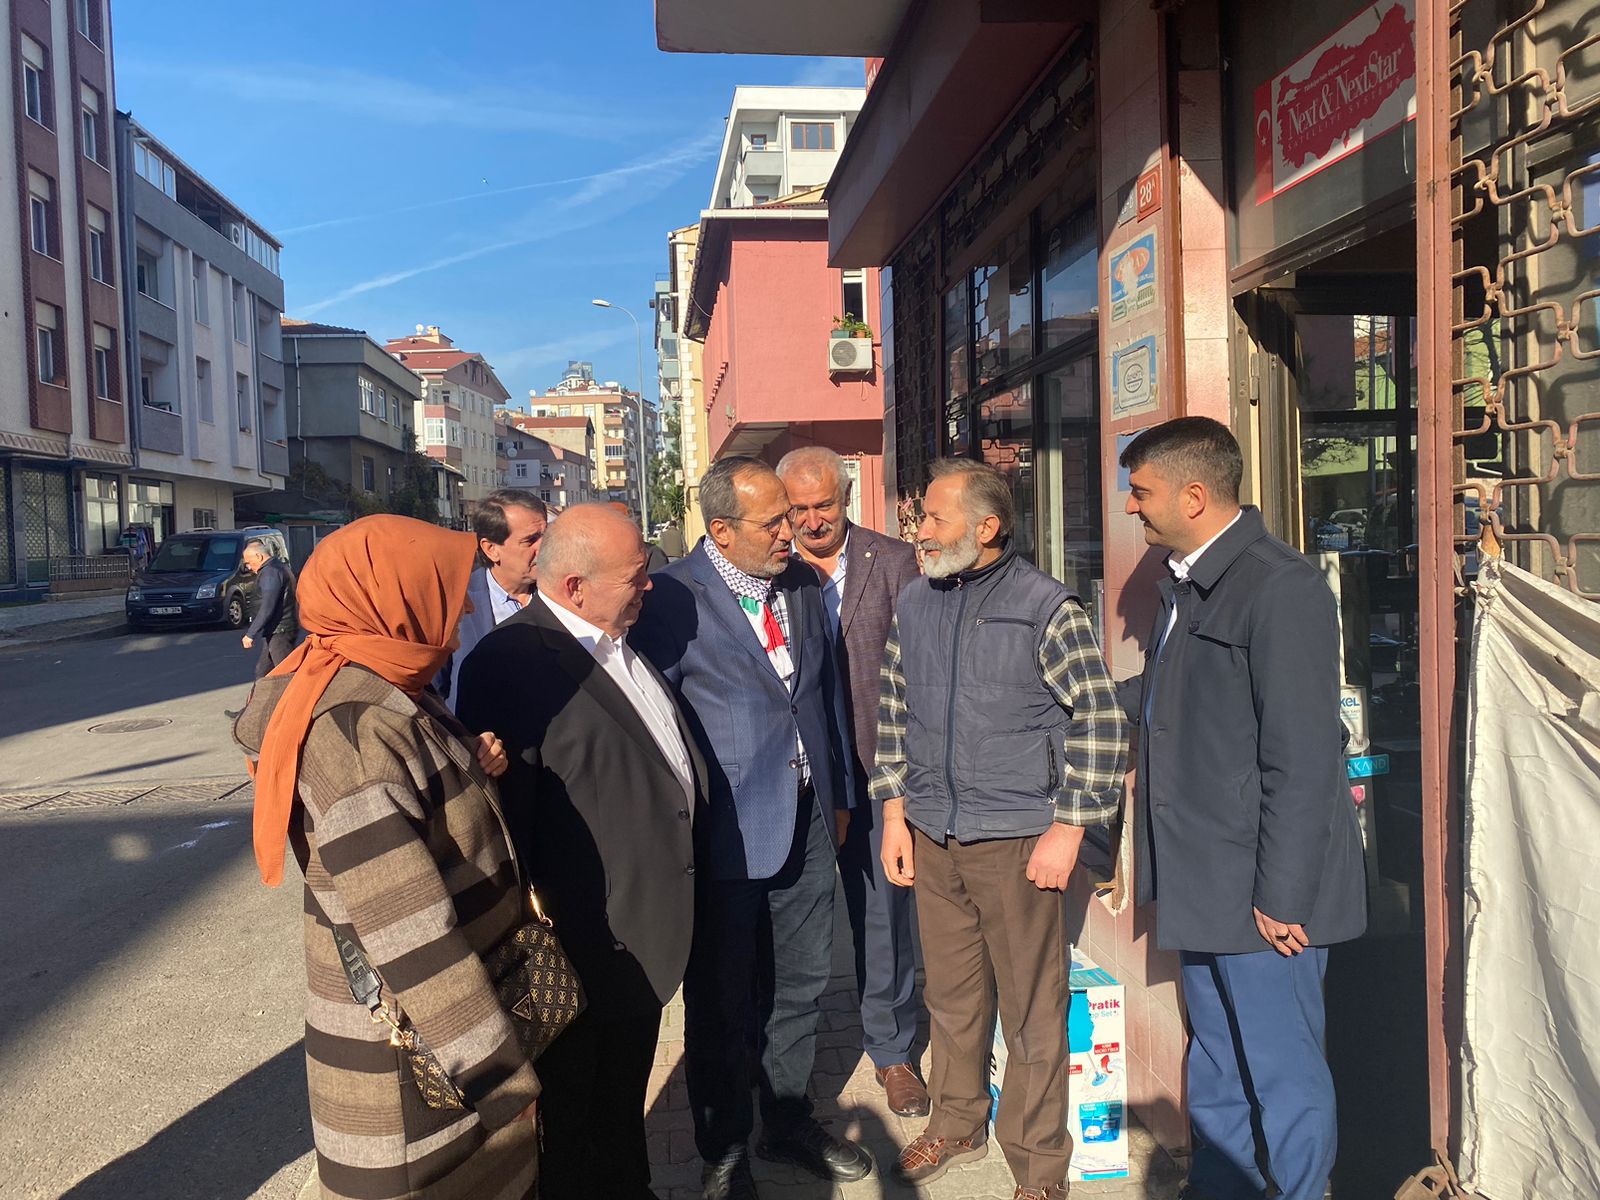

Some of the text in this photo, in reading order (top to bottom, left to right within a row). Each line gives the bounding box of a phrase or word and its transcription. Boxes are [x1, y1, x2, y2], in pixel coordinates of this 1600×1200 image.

[1288, 49, 1402, 141] Next & NextStar
[1288, 77, 1401, 150] SATELLITE SYSTEMS
